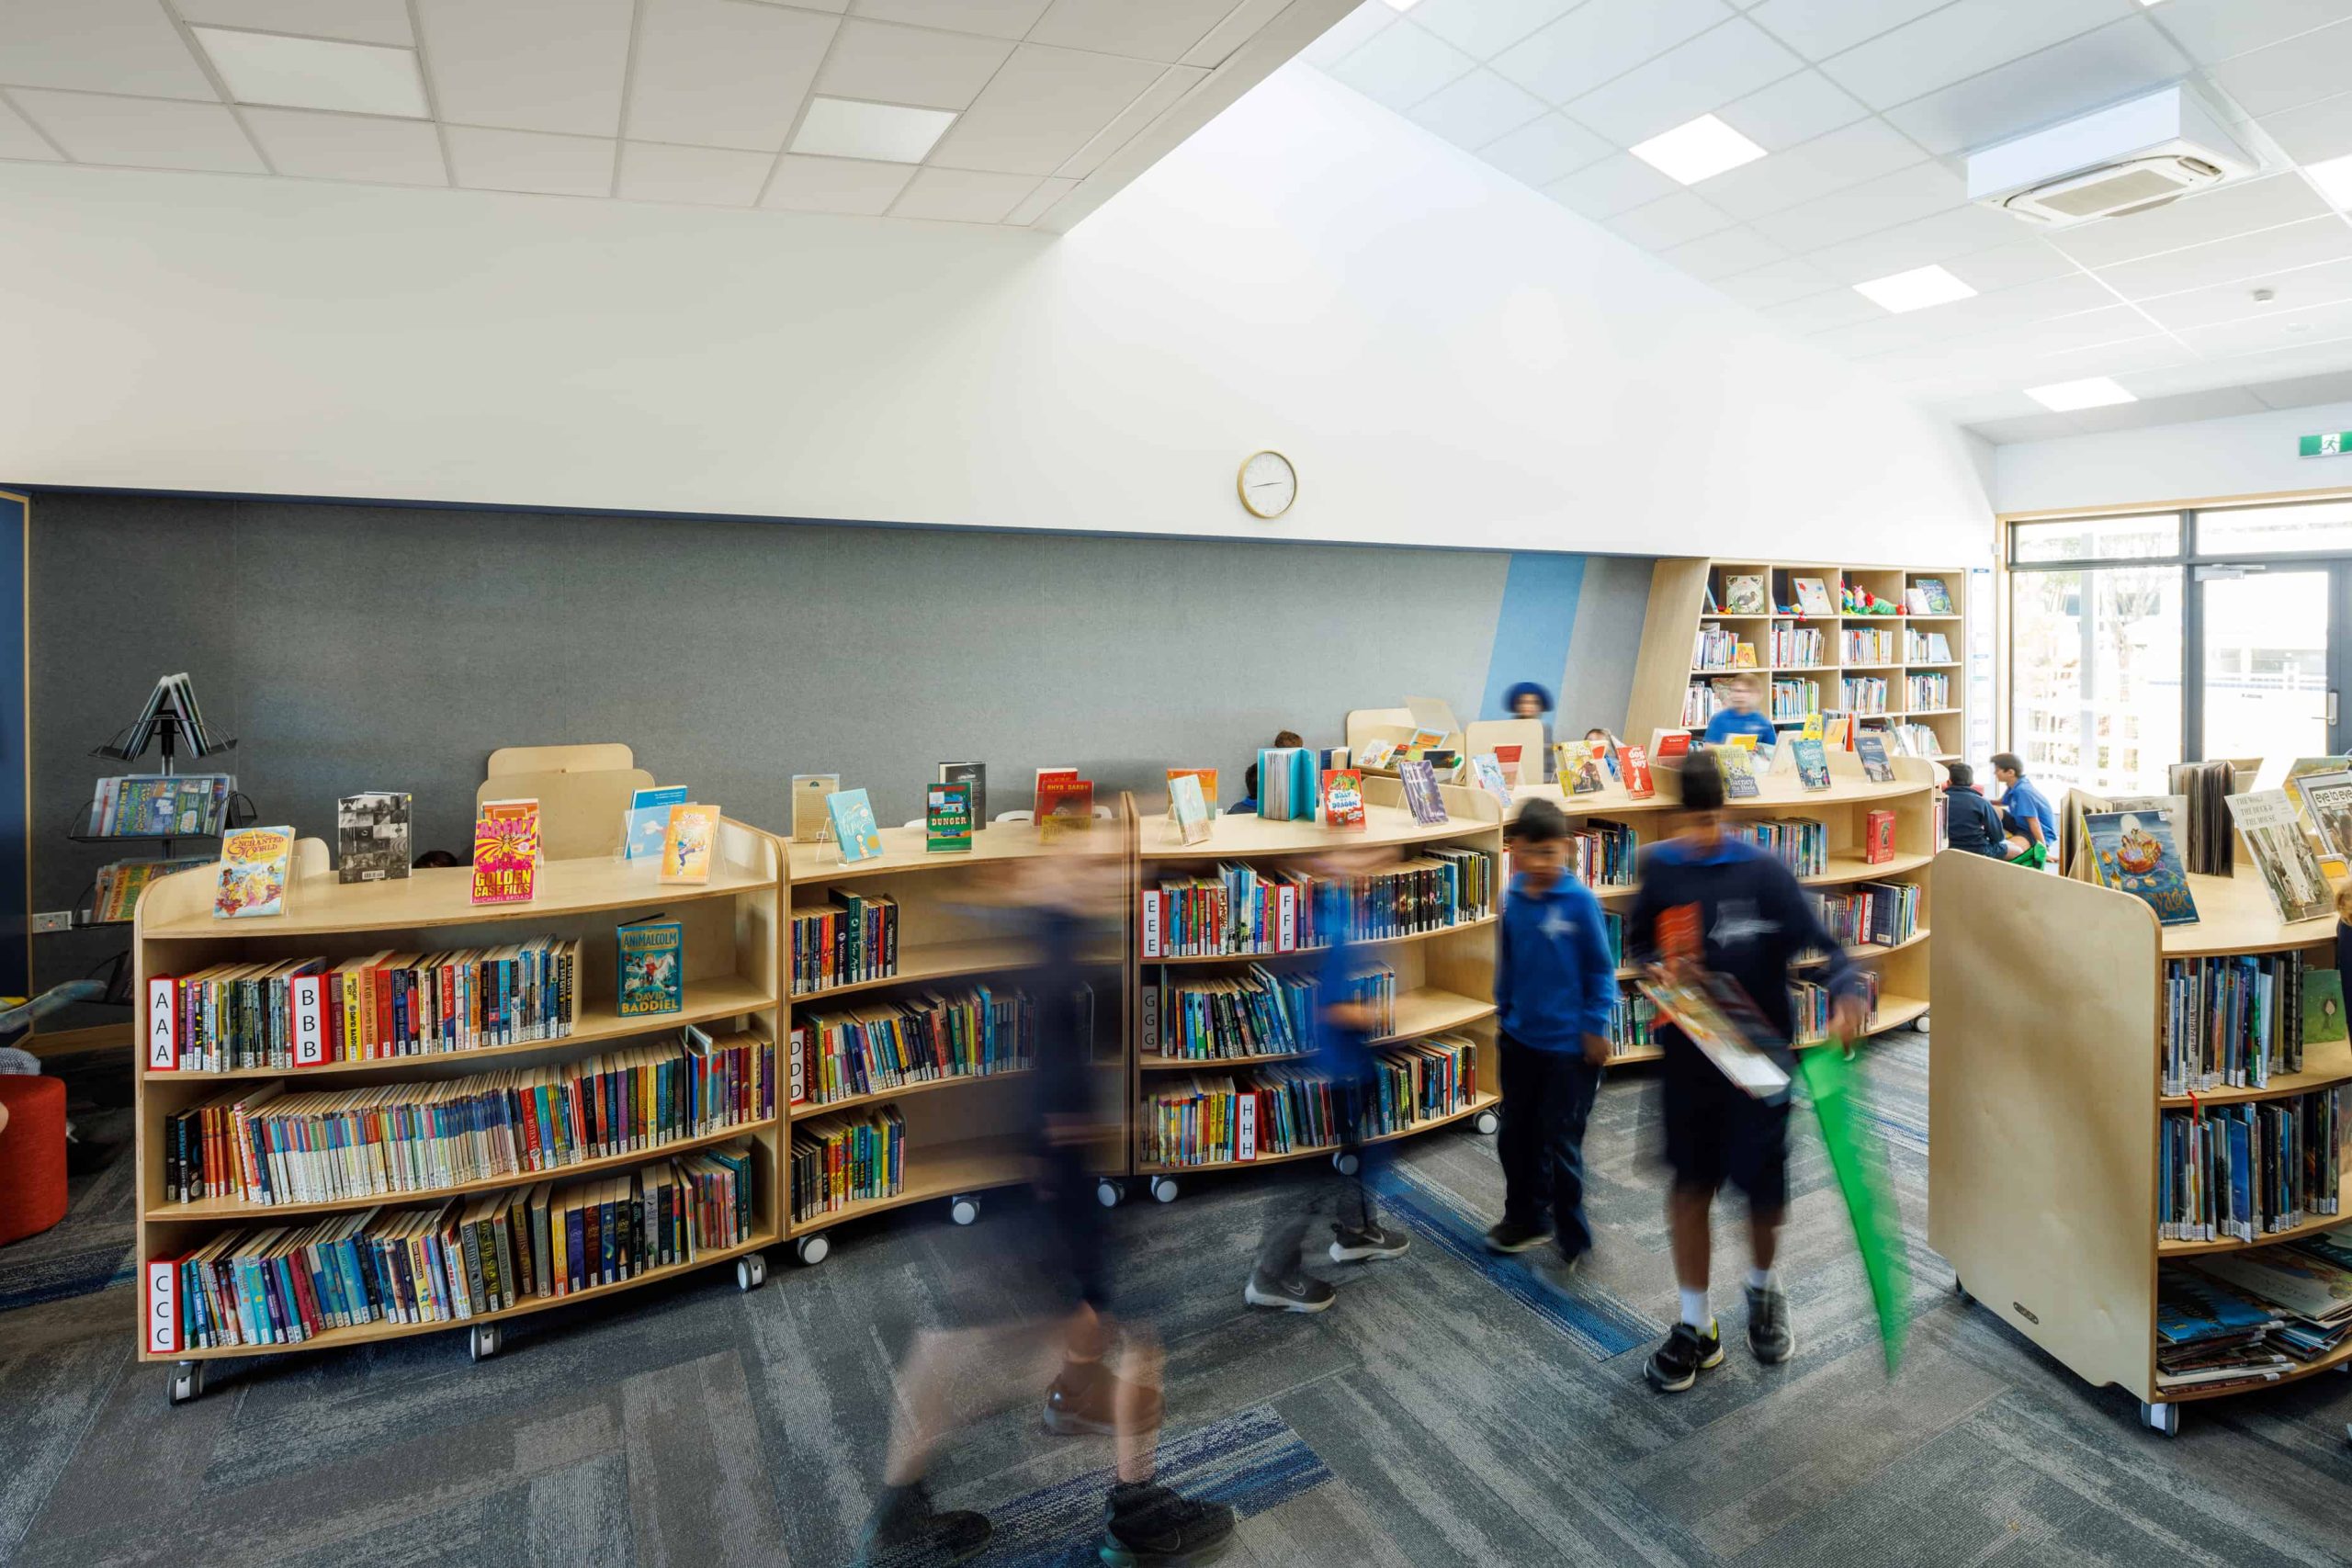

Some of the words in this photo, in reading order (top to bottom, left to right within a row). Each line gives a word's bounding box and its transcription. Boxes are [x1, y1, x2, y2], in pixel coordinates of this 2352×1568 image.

[1334, 791, 1351, 799] BILLY
[2315, 794, 2330, 804] eye
[2331, 792, 2339, 800] to
[2339, 789, 2352, 802] eye
[1332, 800, 1358, 809] DRAGON
[2258, 815, 2276, 824] MOUSE
[478, 817, 535, 838] AGENT
[232, 836, 284, 847] ENCHANTED
[475, 870, 531, 887] GOLDEN
[474, 885, 502, 897] CASE
[504, 883, 531, 895] FILES
[1148, 900, 1156, 912] E
[1284, 895, 1290, 907] F
[1148, 920, 1156, 932] E
[1284, 915, 1290, 926] F
[1148, 940, 1156, 951] E
[1284, 934, 1290, 946] F
[155, 992, 169, 1009] A
[302, 990, 314, 1005] B
[635, 993, 666, 1002] DAVID
[1145, 995, 1155, 1007] G
[622, 999, 678, 1013] BADDIEL
[303, 1016, 315, 1032] B
[1145, 1014, 1155, 1026] G
[156, 1019, 169, 1035] A
[1145, 1033, 1155, 1045] G
[156, 1045, 169, 1061] A
[304, 1041, 316, 1057] B
[791, 1041, 801, 1055] D
[791, 1063, 802, 1076] D
[791, 1084, 802, 1098] D
[1244, 1104, 1252, 1116] H
[1244, 1124, 1252, 1135] H
[1244, 1143, 1252, 1155] H
[156, 1276, 168, 1292] C
[157, 1302, 169, 1318] C
[157, 1328, 169, 1344] C
